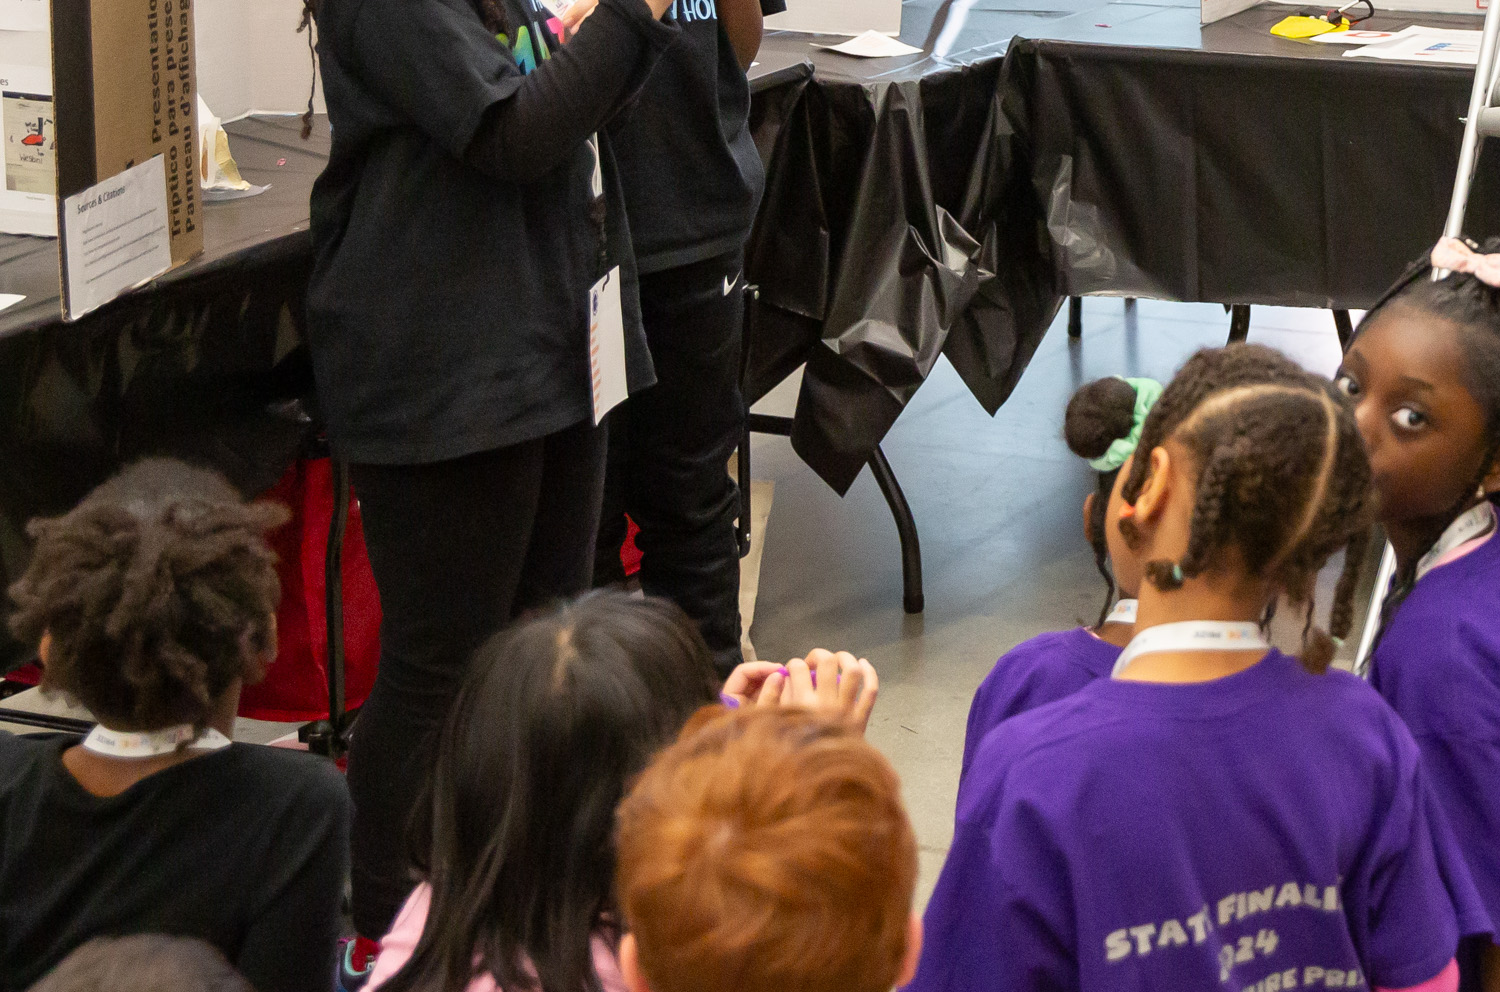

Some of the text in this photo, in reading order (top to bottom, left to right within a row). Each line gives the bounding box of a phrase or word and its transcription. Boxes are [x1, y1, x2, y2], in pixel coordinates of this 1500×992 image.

[166, 79, 179, 136] para
[77, 185, 125, 214] Sources & Citations
[183, 125, 195, 235] Panneau
[1105, 904, 1213, 962] STAT
[1217, 875, 1342, 926] FINALI
[1303, 966, 1364, 988] PRI
